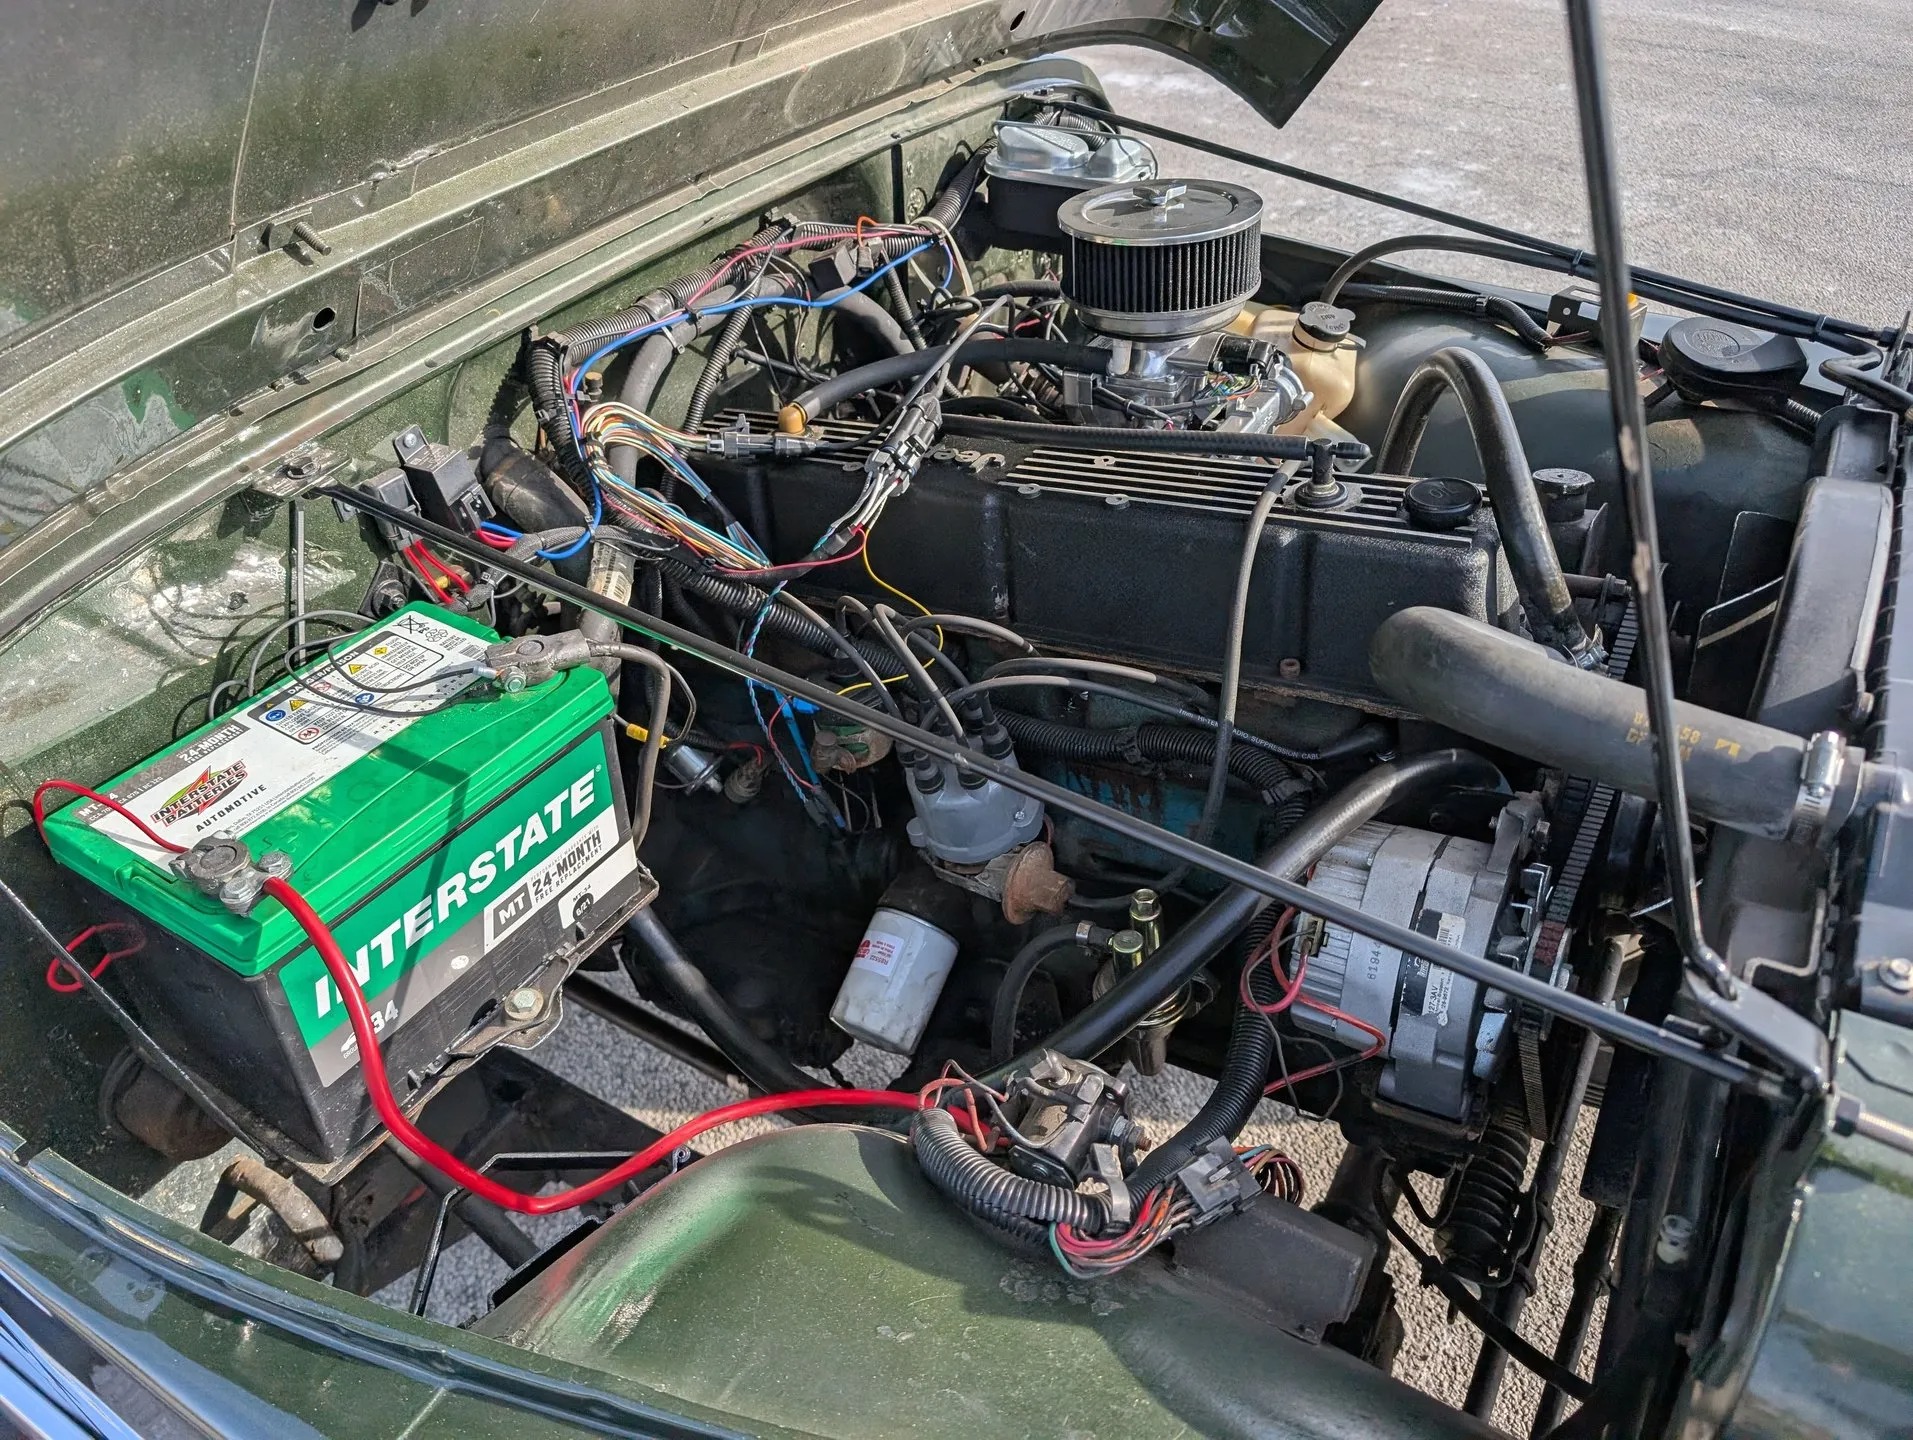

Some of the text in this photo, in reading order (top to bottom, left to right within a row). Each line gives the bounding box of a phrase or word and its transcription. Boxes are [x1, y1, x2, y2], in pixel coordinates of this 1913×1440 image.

[288, 651, 359, 695] DAGER/PISON
[178, 724, 242, 762] 24-MONTH
[1232, 728, 1249, 739] ADIO
[1250, 735, 1298, 758] SUPPRESSION
[1301, 752, 1320, 760] CABL
[79, 793, 118, 817] MT-4
[152, 762, 245, 822] INTERSTATE
[164, 770, 247, 826] BATTERIES
[196, 784, 267, 832] AUTOMOTIVE
[533, 830, 602, 897] 24-MONTH
[535, 845, 603, 904] FREE REPLACEMENT
[315, 769, 596, 1019] INTERSTATE
[499, 892, 525, 925] MT
[370, 1000, 399, 1034] 34
